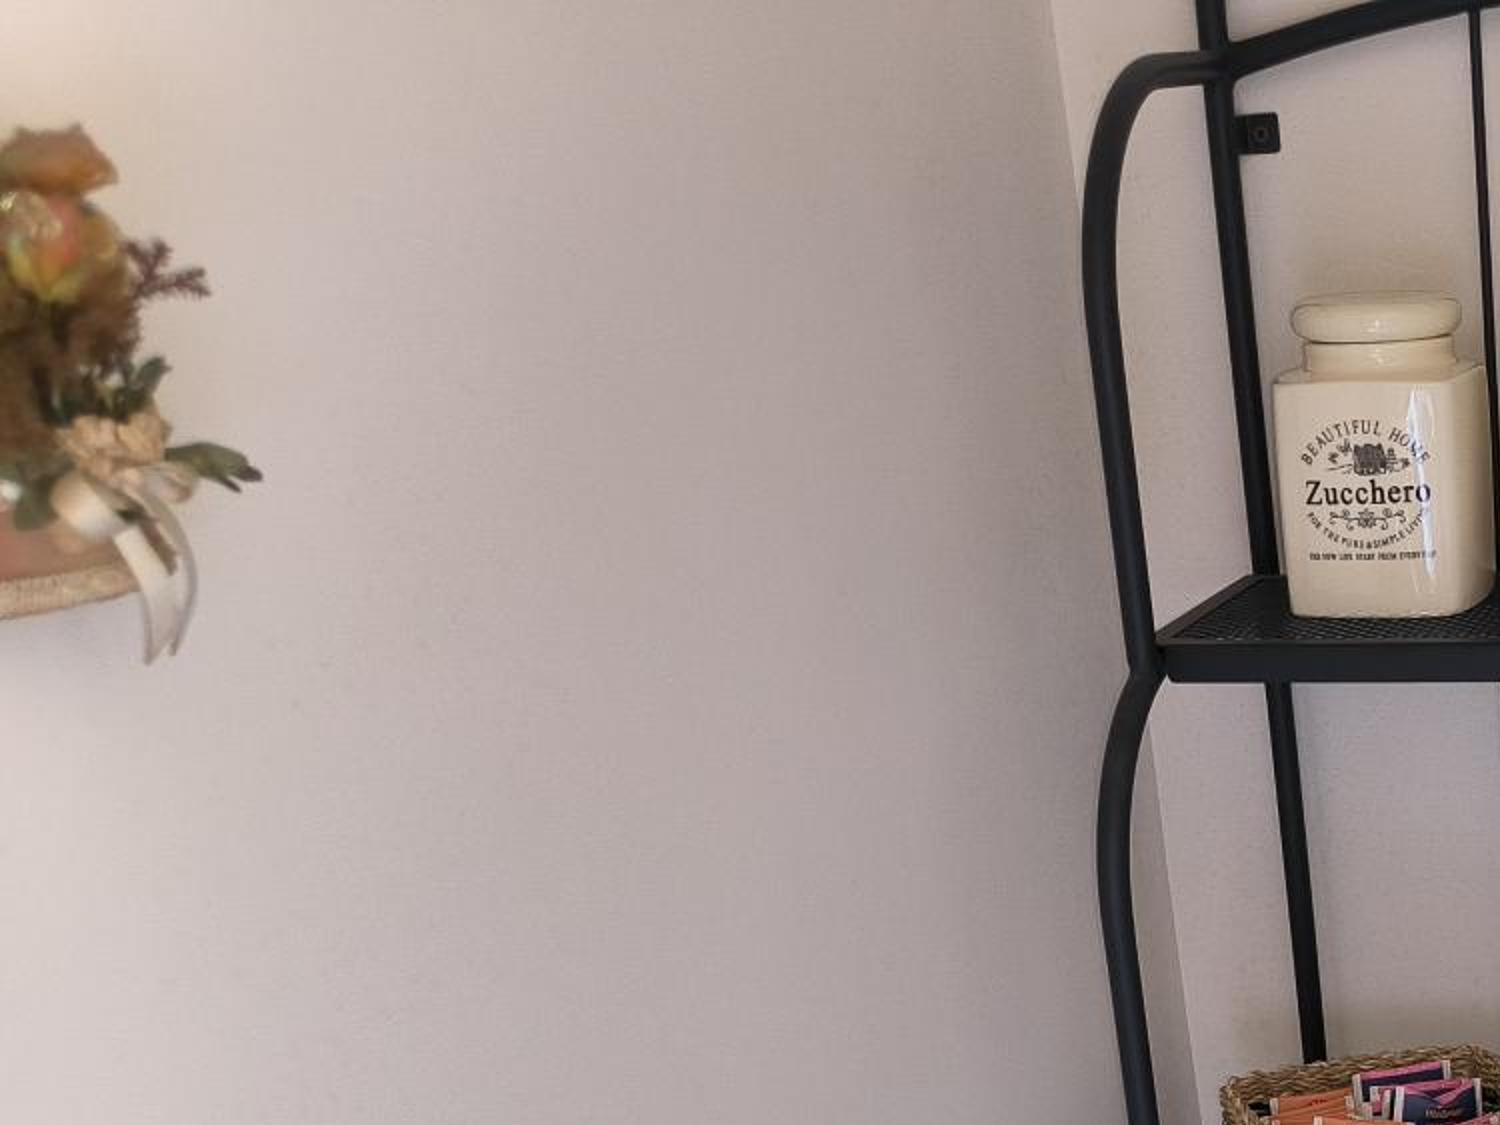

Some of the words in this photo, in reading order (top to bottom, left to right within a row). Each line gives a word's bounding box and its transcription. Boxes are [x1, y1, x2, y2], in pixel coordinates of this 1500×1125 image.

[1301, 419, 1382, 465] BEAUTIFUL
[1388, 426, 1431, 463] HOME
[1305, 479, 1431, 505] Zucchero
